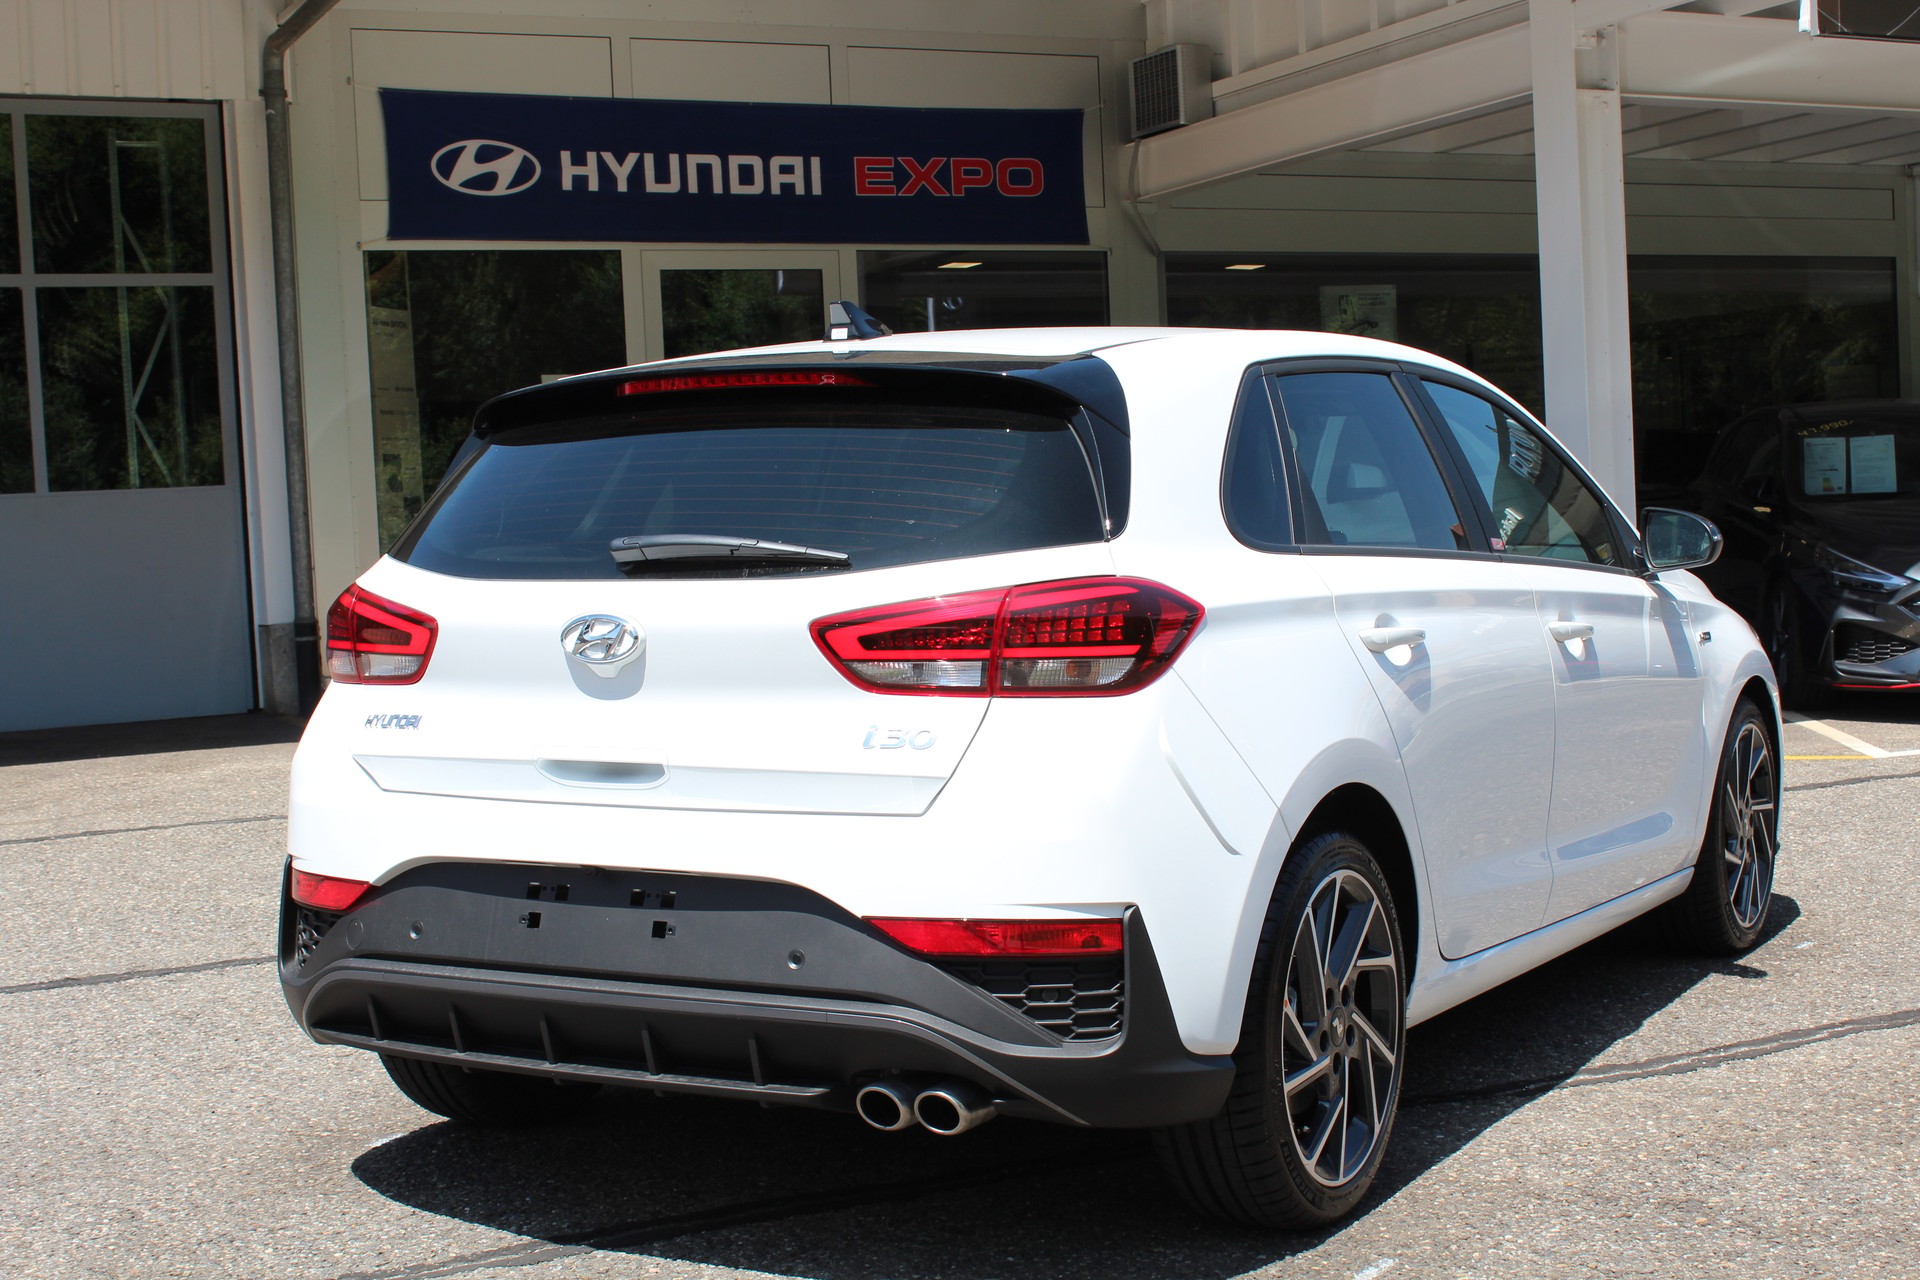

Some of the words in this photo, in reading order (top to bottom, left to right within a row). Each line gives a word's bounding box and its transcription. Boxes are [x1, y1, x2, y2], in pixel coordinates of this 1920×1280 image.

[560, 150, 822, 196] HYUNDAI
[853, 156, 1045, 197] EXPO
[363, 712, 422, 731] HYUNDAI
[862, 724, 938, 752] i30
